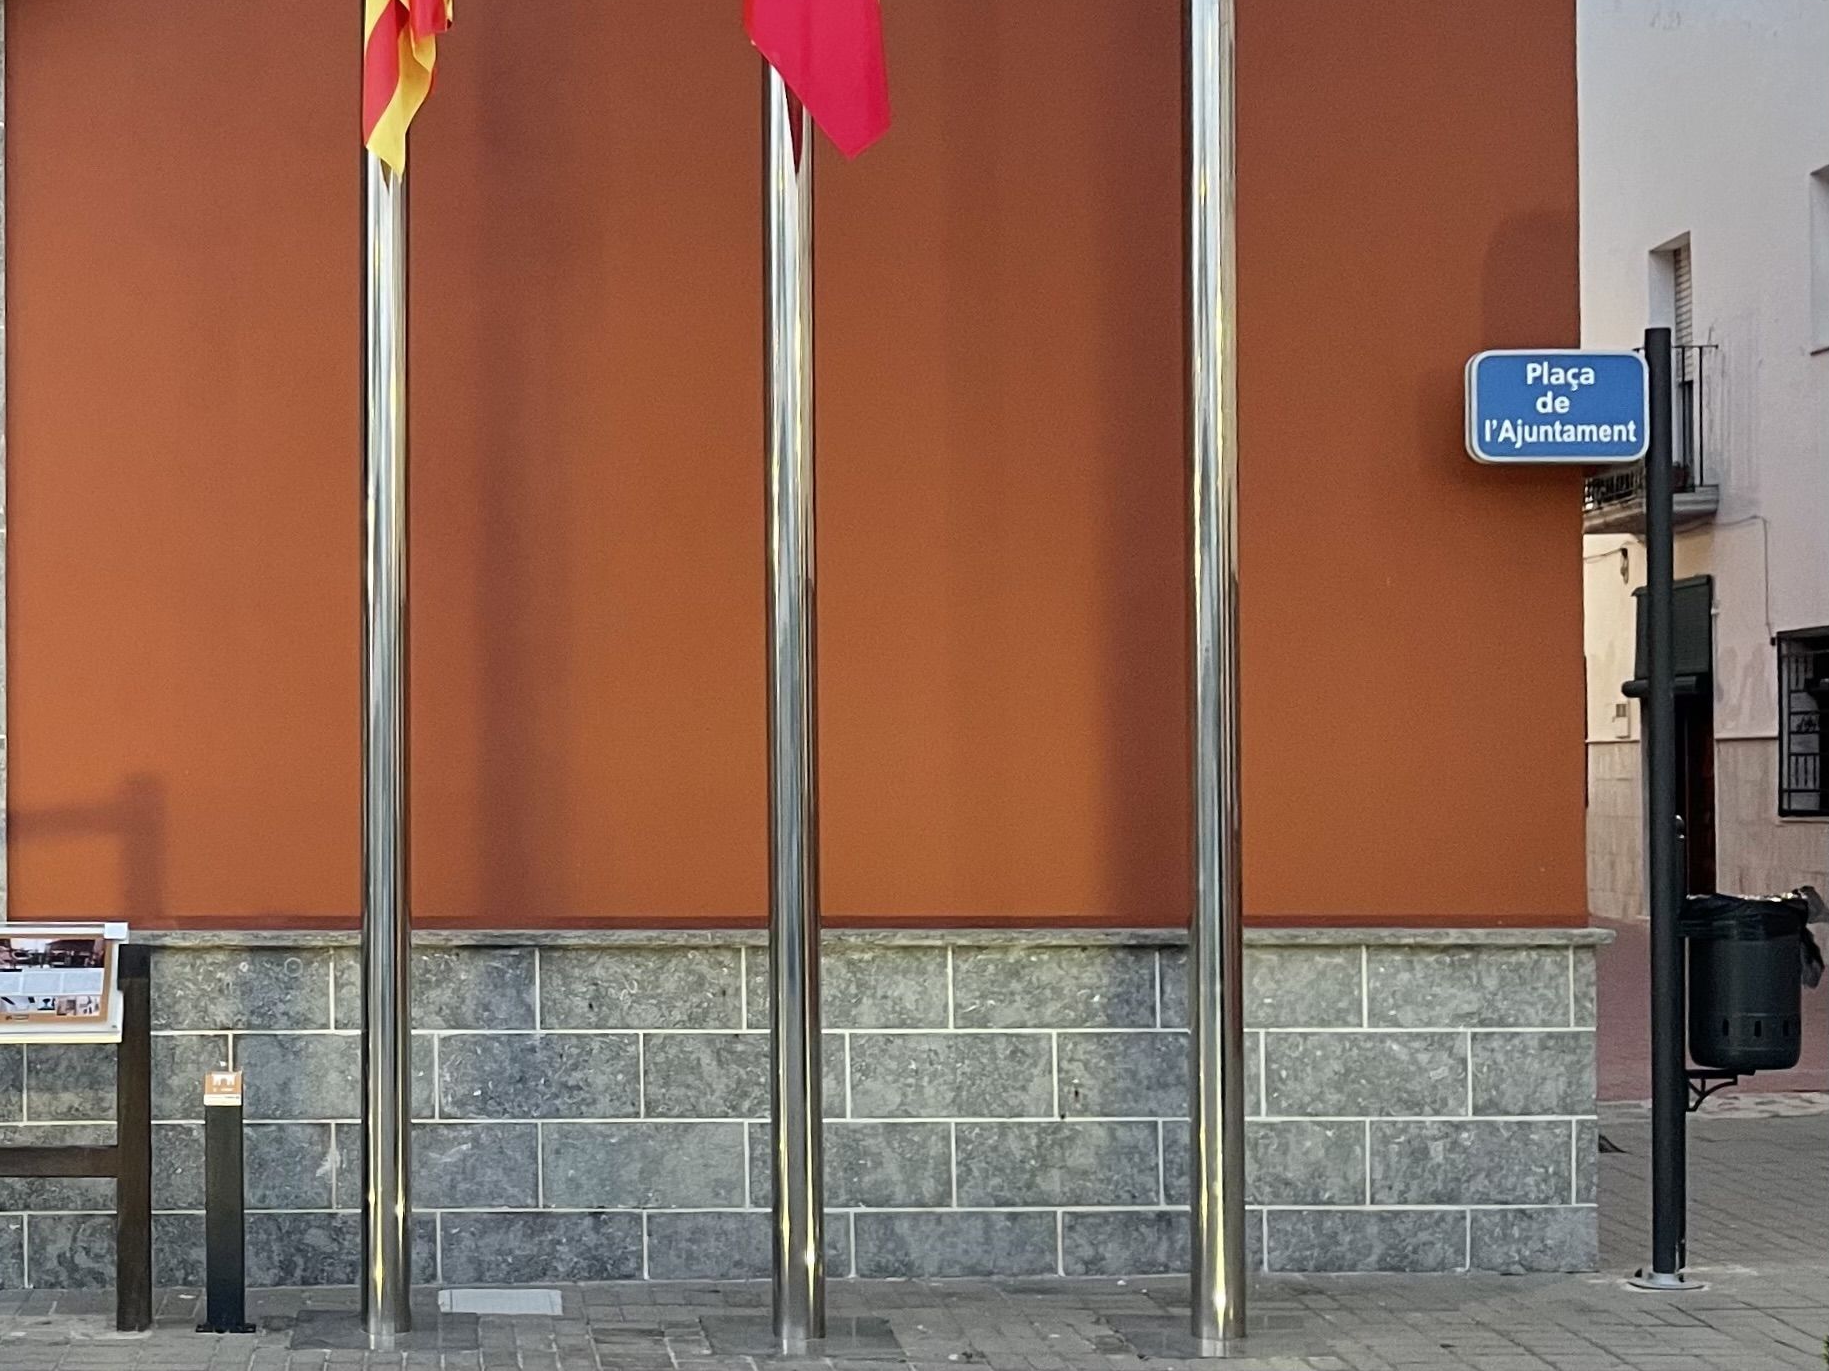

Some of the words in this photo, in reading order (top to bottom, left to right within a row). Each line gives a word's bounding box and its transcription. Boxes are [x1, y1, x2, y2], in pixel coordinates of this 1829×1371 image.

[1526, 362, 1595, 391] Plaça
[1535, 391, 1570, 413] de
[1484, 419, 1637, 448] l'Ajuntament
